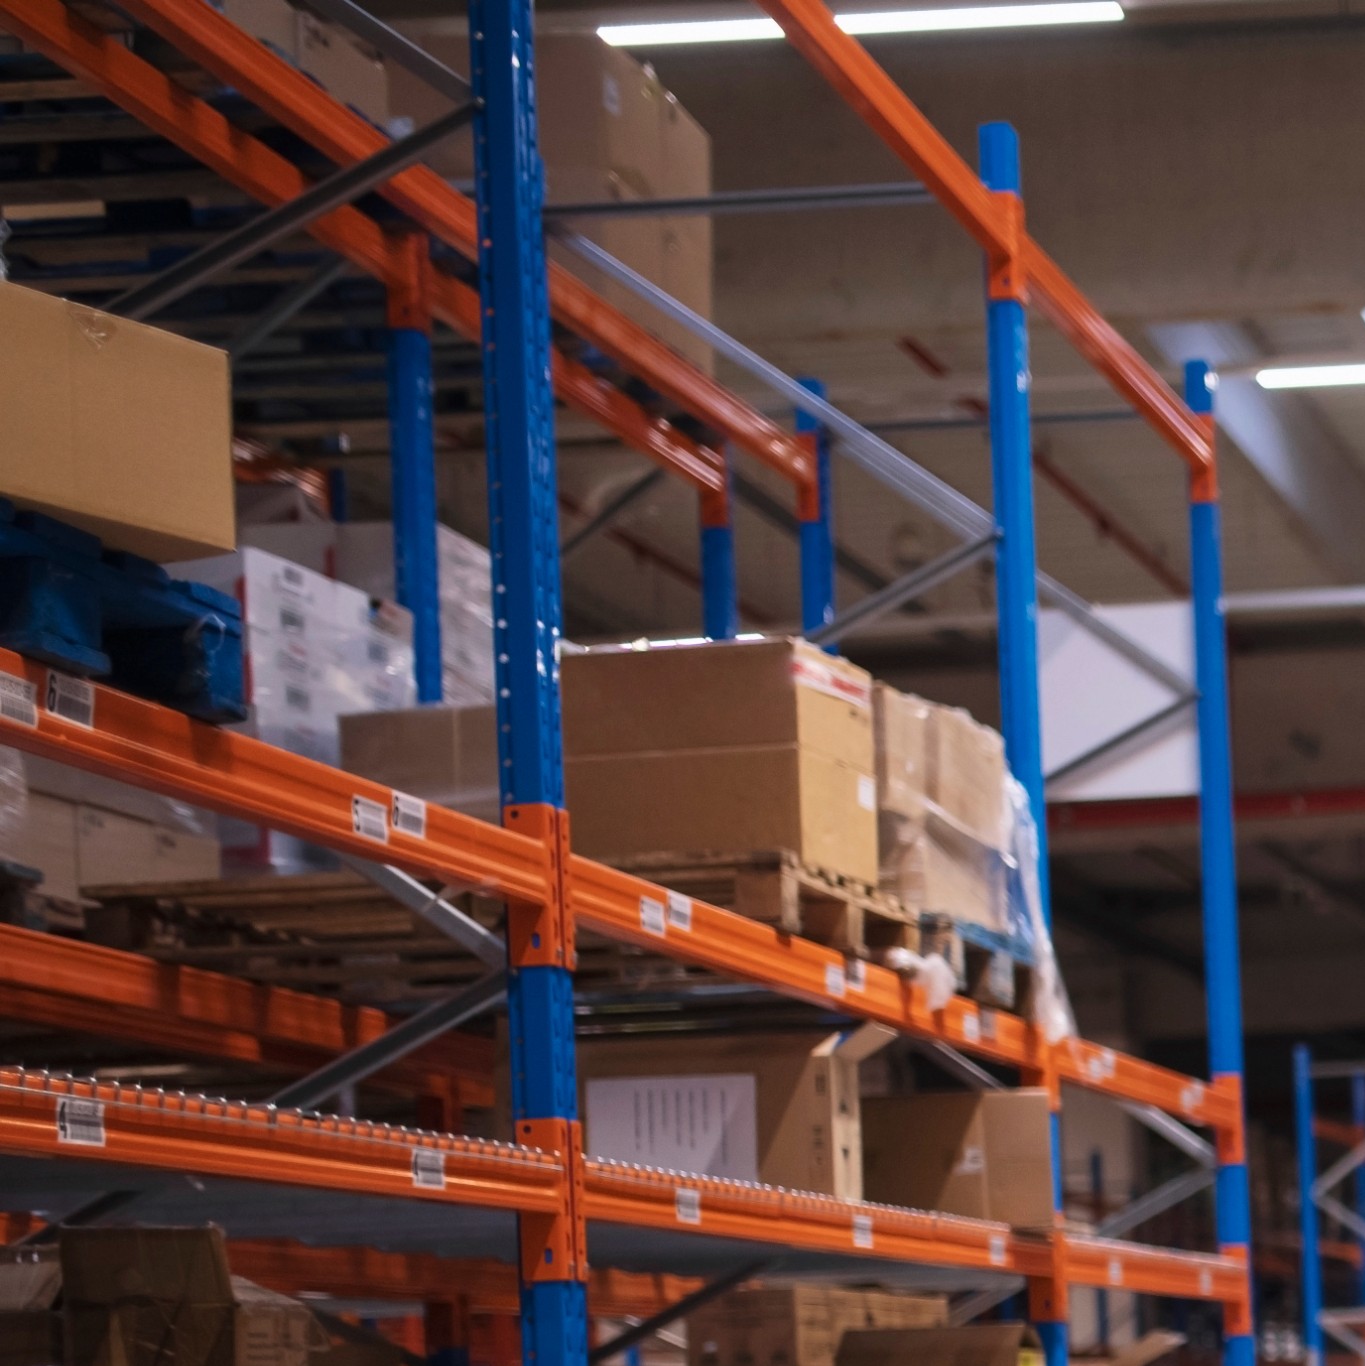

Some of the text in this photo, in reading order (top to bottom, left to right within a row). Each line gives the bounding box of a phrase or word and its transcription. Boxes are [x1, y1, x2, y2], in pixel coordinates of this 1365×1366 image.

[47, 673, 57, 712] 6
[353, 798, 361, 832] 5
[393, 795, 400, 826] 6
[59, 1101, 68, 1139] 4
